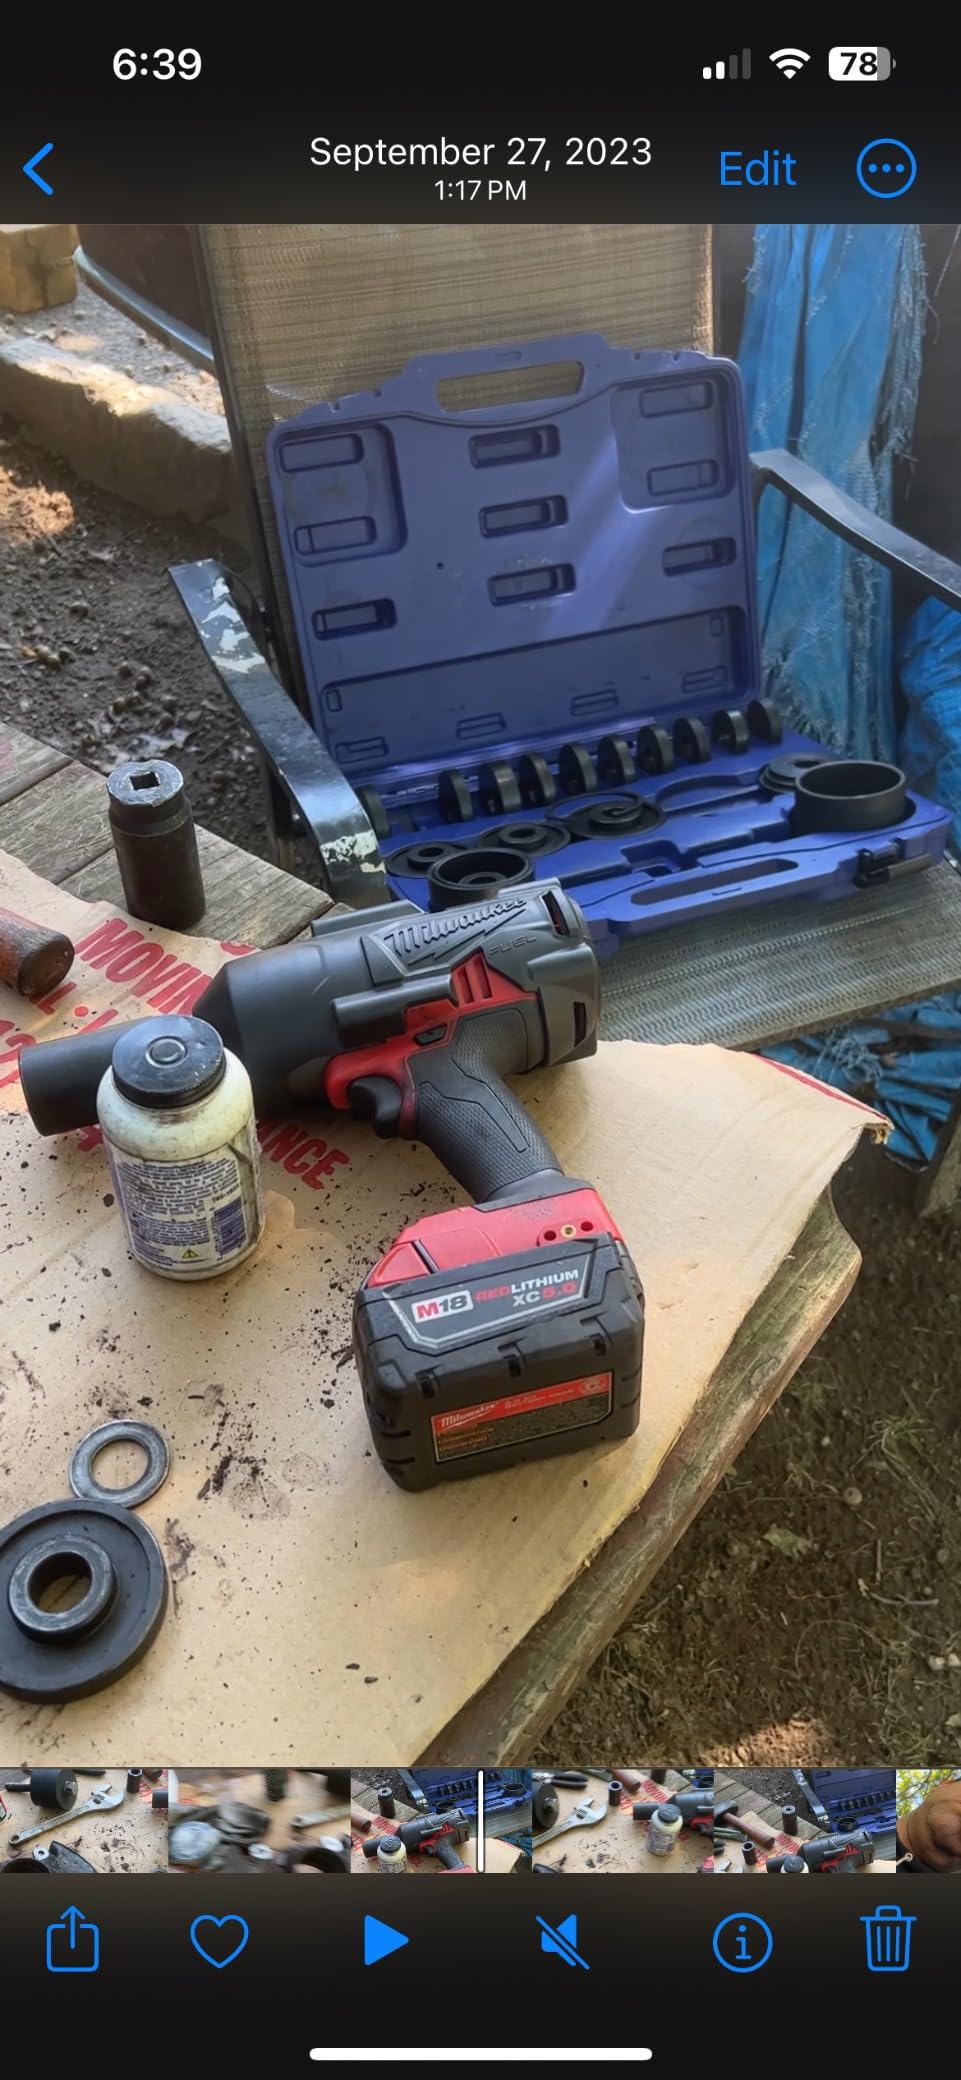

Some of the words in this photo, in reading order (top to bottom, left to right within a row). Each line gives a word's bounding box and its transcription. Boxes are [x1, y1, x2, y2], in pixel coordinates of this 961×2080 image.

[384, 899, 527, 957] Milwaukee
[488, 934, 537, 956] FUEL
[74, 918, 213, 1015] MOVIN
[416, 1294, 470, 1319] M18
